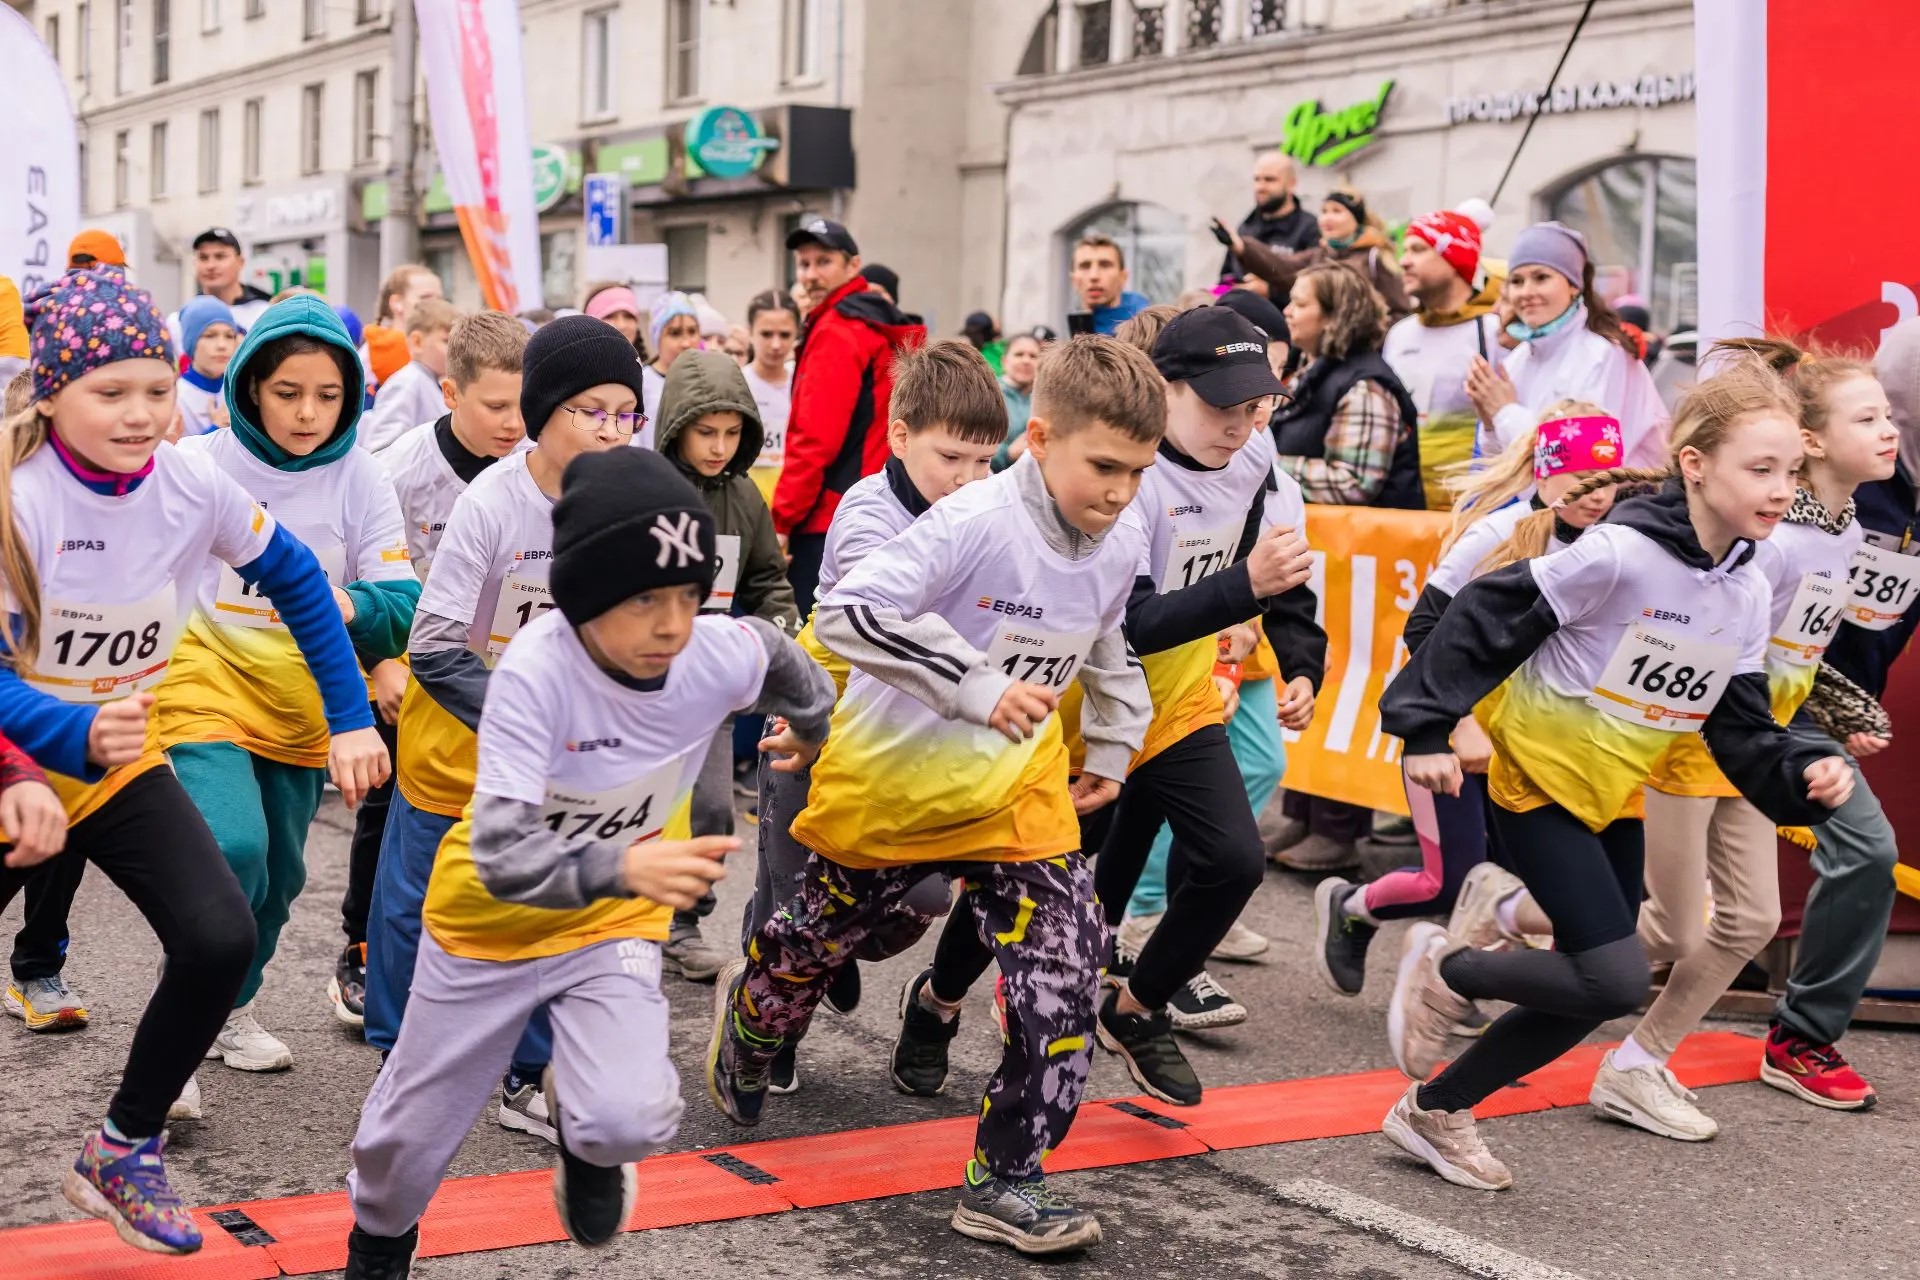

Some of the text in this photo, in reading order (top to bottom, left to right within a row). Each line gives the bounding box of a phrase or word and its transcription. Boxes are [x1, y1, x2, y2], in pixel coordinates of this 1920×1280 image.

[1226, 342, 1264, 354] ЕВРАЗ
[764, 431, 782, 449] 61
[648, 511, 705, 568] NY
[524, 550, 554, 561] ЕВРА
[61, 609, 104, 622] ЕВРАЗ
[992, 599, 1043, 620] ЕВРАЗ
[1653, 609, 1691, 625] ЕВРАЗ
[54, 620, 161, 668] 1708
[1012, 634, 1045, 647] ЕВРАЗ
[1643, 634, 1676, 652] ЕВРАЗ
[1001, 653, 1077, 688] 1730
[1627, 653, 1716, 702] 1686
[544, 792, 655, 841] 1764
